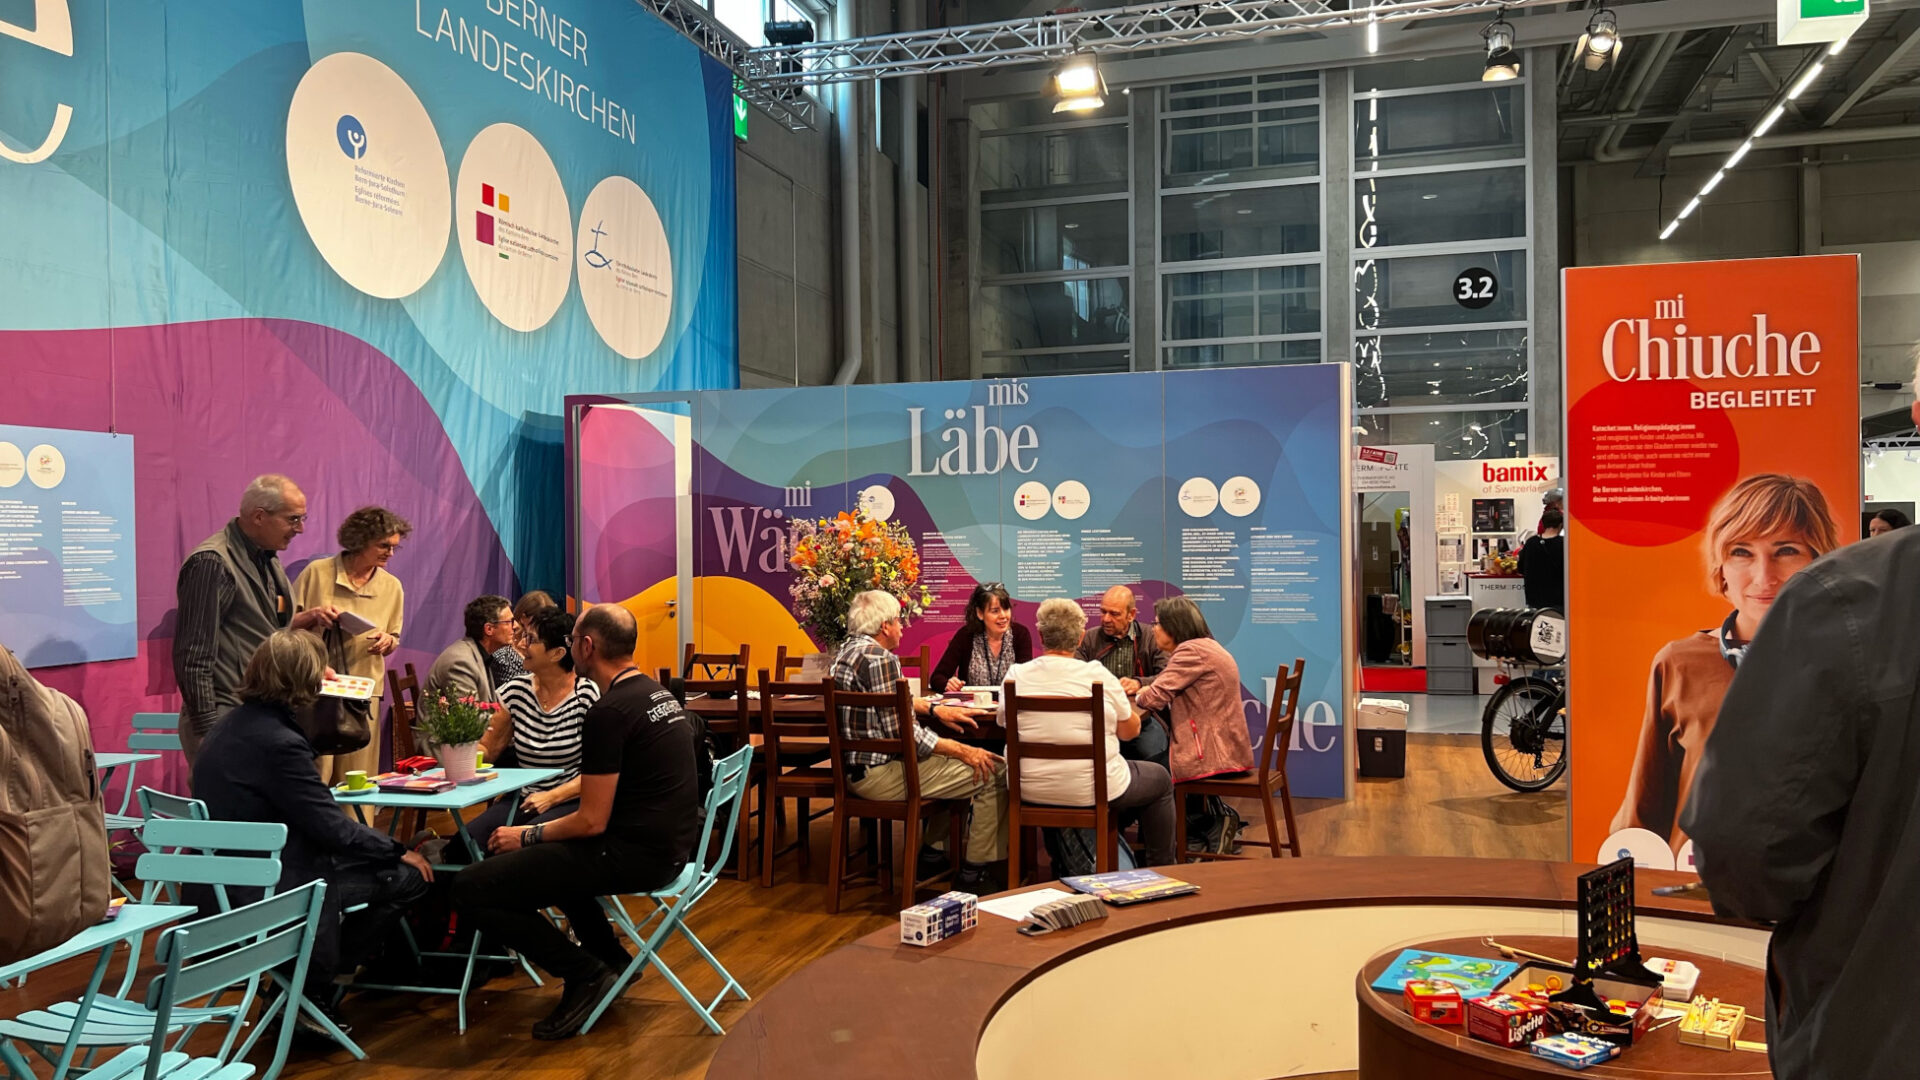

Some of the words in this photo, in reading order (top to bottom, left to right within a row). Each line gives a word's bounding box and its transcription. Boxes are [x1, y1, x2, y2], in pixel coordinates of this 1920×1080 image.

[416, 0, 635, 145] LANDESKIRCHEN
[1458, 277, 1493, 300] 3.2
[1655, 294, 1685, 320] mi
[1602, 313, 1821, 383] Chiuche
[988, 378, 1029, 406] mis
[1690, 389, 1816, 410] BEGLEITET
[907, 405, 1039, 476] Läbe
[1483, 461, 1548, 483] bamix
[784, 480, 812, 507] mi
[1482, 485, 1492, 494] of
[1495, 484, 1549, 494] Switzerlan
[707, 506, 802, 573] Wä
